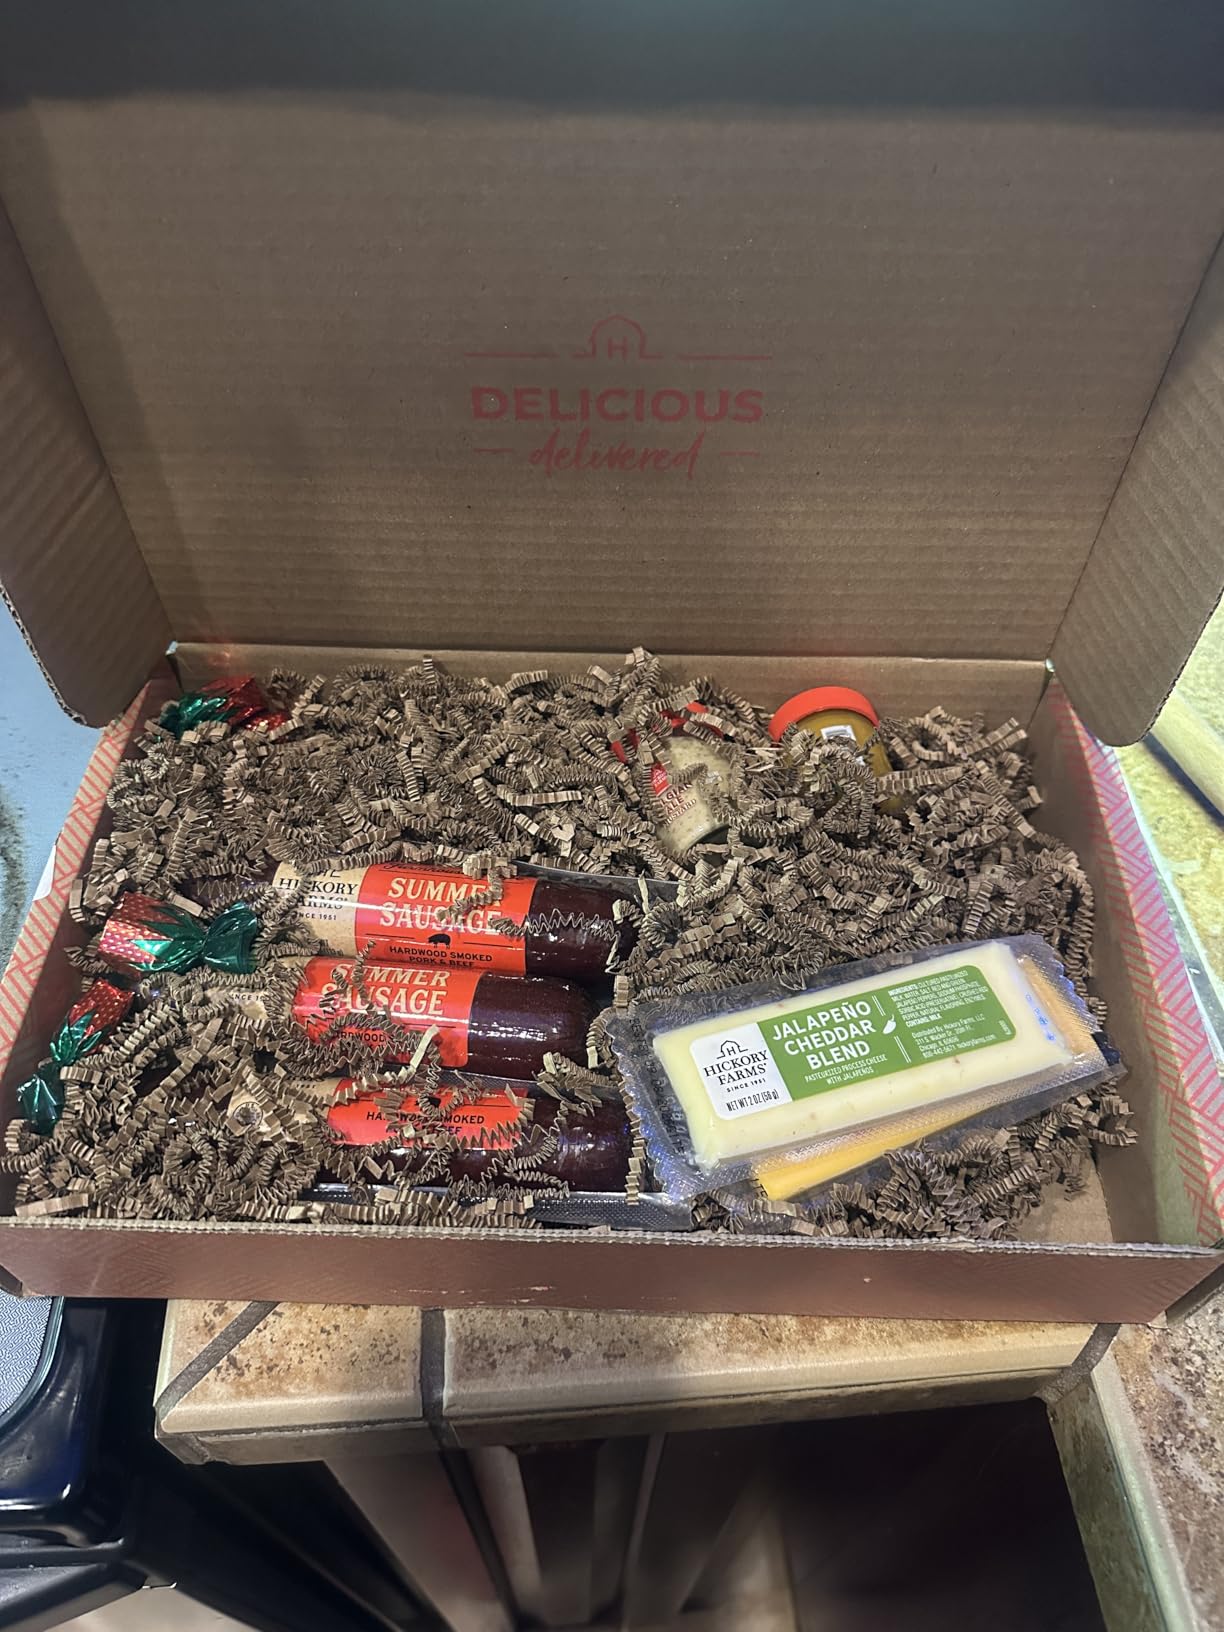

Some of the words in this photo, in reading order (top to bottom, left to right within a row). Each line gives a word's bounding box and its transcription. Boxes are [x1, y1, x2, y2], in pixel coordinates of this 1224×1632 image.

[471, 386, 764, 422] DELICIOUS
[528, 427, 706, 480] delivered
[280, 878, 359, 895] HIKORY
[389, 945, 447, 958] HARDWOOD
[450, 951, 493, 962] SMOKED
[409, 956, 436, 966] PORK
[449, 959, 475, 968] BEEF
[331, 964, 450, 987] SMMER
[772, 1001, 871, 1041] JALAPEÑO
[784, 1019, 877, 1056] CHEDDAR
[703, 1049, 769, 1077] HICKORY
[805, 1040, 870, 1070] BLEND
[804, 1065, 842, 1083] PASTEURIZED
[841, 1061, 867, 1074] PROCESS
[865, 1054, 888, 1066] CHEESE
[726, 1082, 749, 1093] SINCE
[826, 1076, 841, 1085] WITH
[726, 1099, 739, 1112] NET
[738, 1096, 749, 1109] WT
[748, 1095, 754, 1106] 2
[752, 1093, 763, 1105] OZ
[444, 1113, 485, 1124] MOKED
